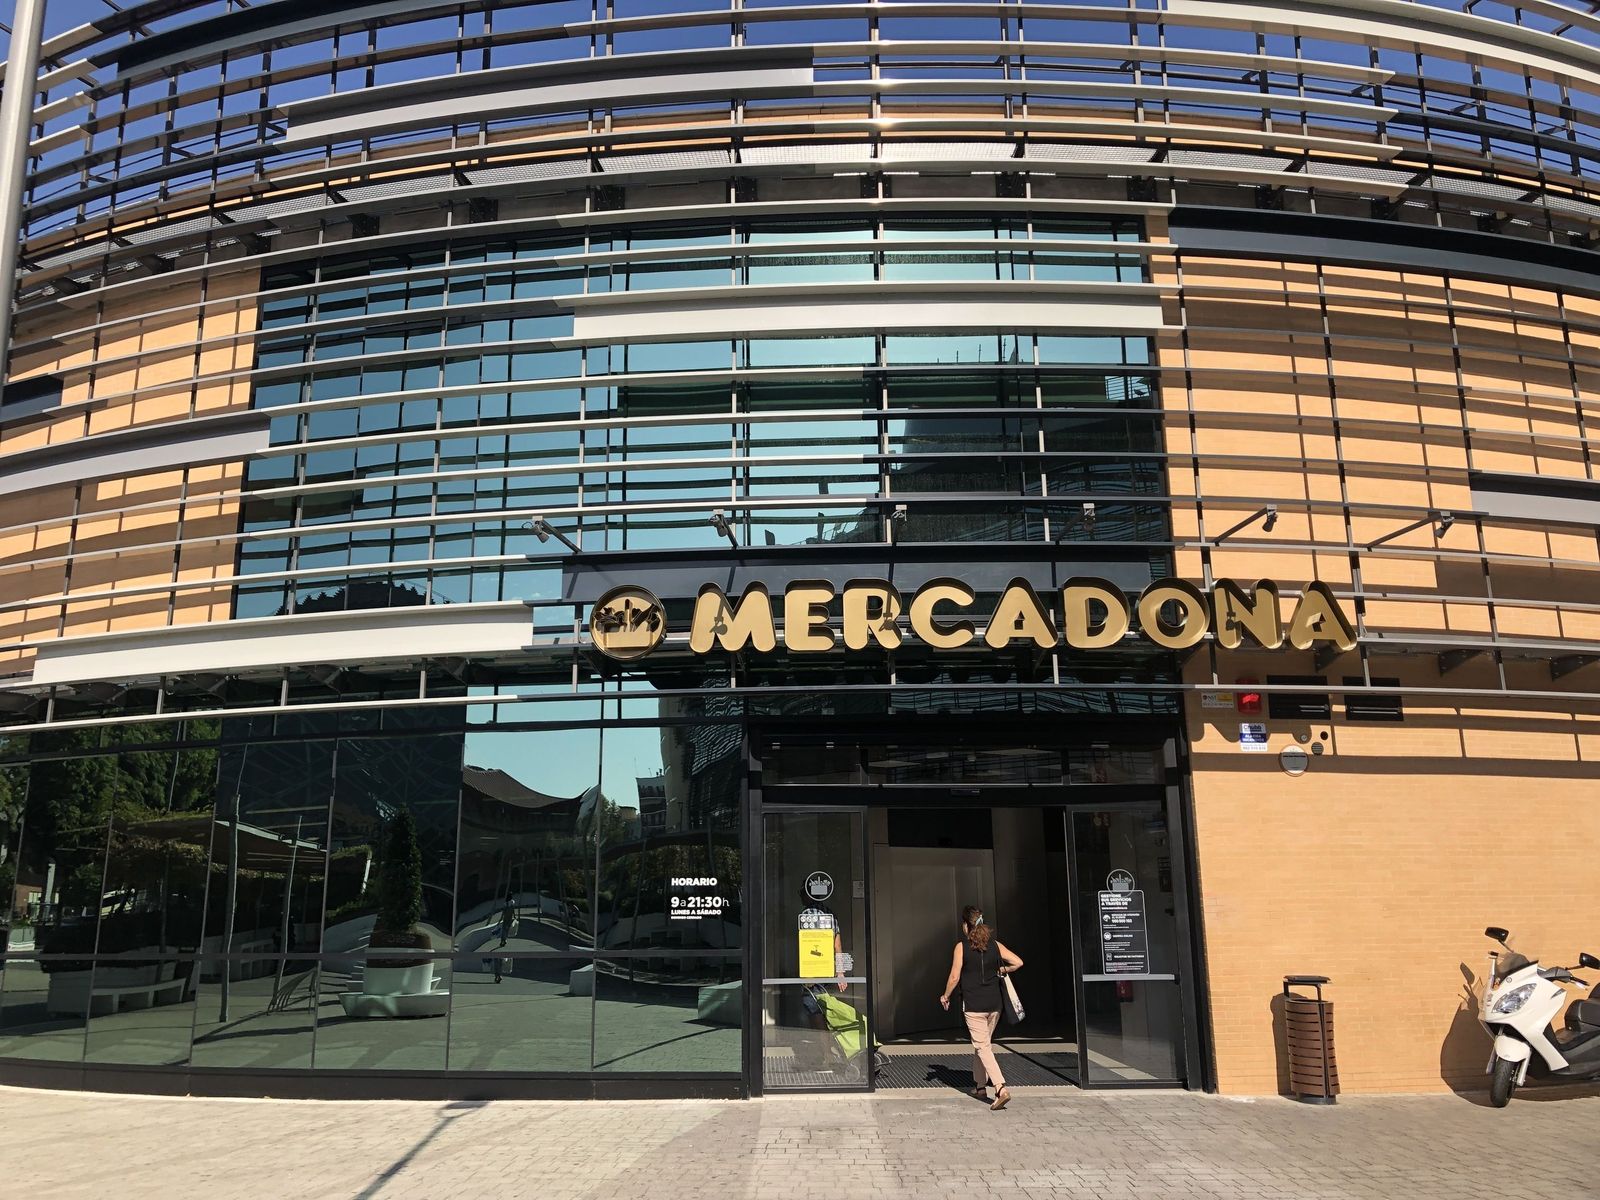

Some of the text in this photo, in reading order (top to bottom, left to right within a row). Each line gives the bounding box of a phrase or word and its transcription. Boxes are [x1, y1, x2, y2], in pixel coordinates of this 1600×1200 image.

[689, 576, 1357, 653] MERCADONA
[671, 877, 718, 886] HORARIO
[671, 896, 680, 908] 9
